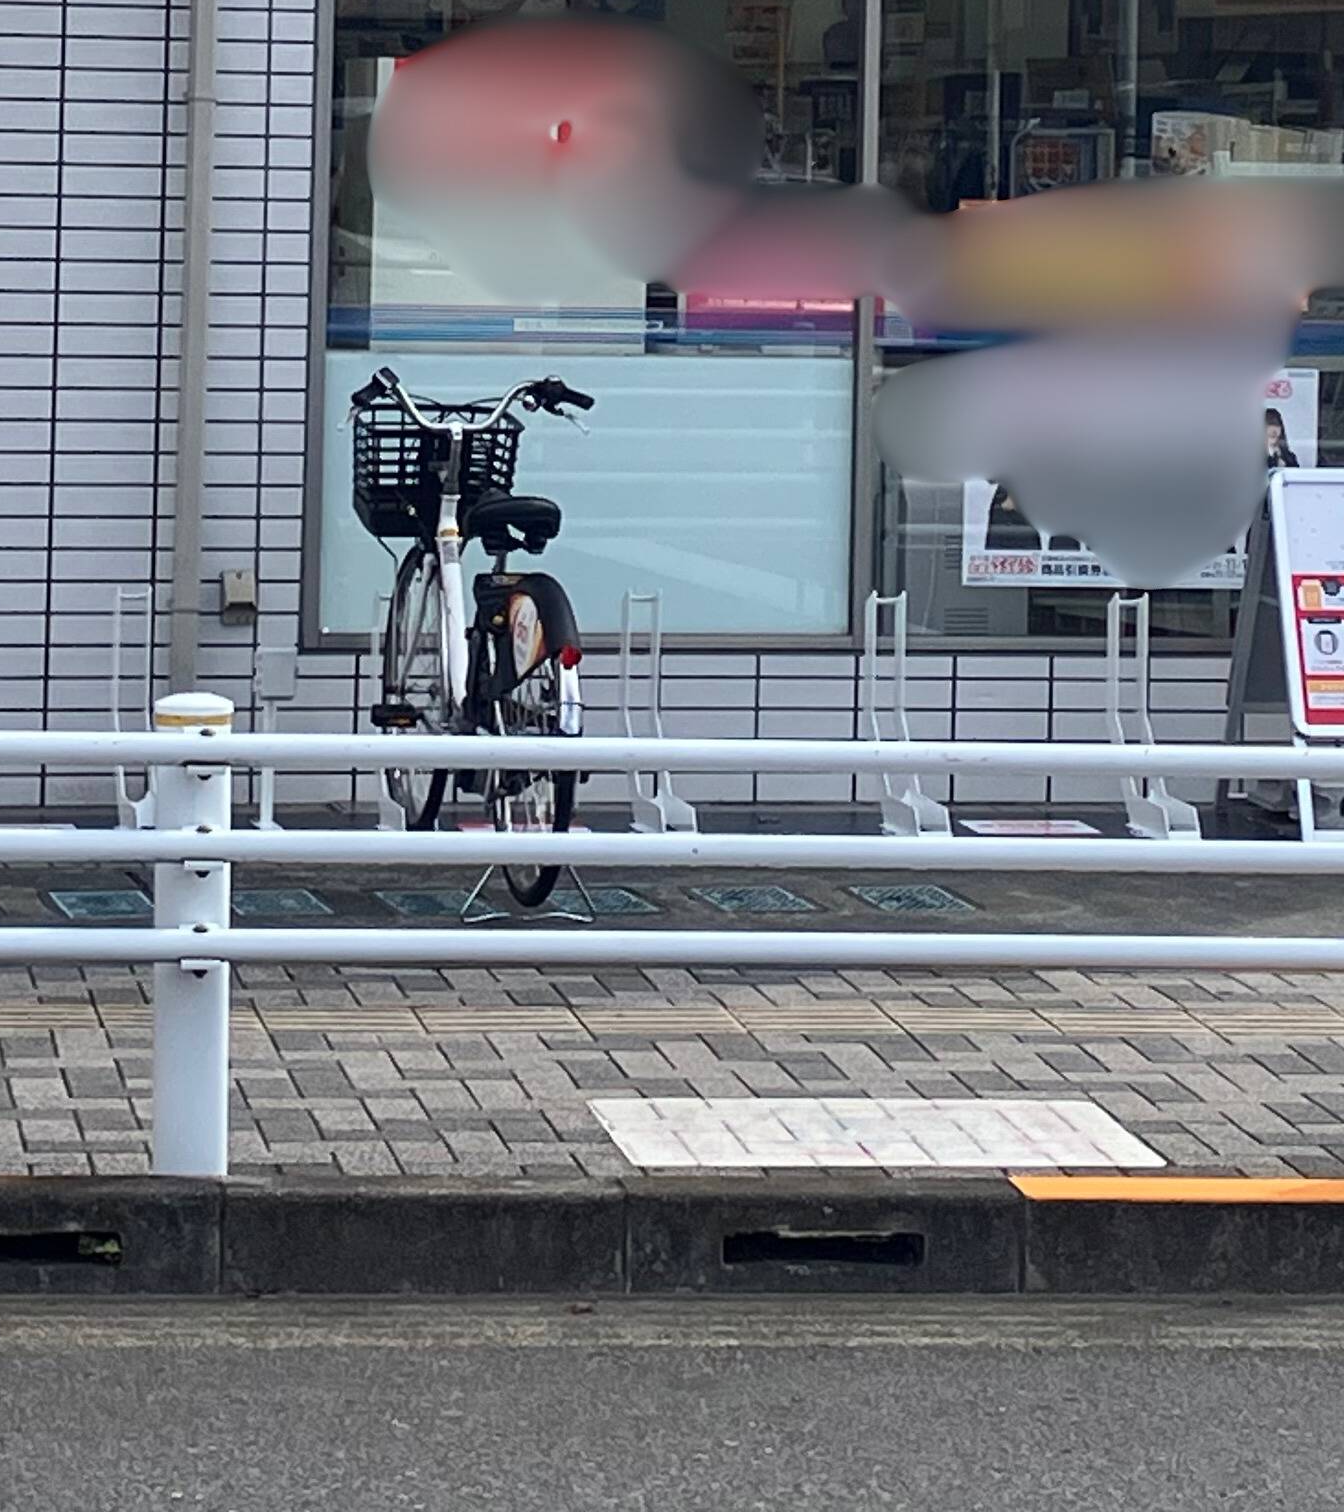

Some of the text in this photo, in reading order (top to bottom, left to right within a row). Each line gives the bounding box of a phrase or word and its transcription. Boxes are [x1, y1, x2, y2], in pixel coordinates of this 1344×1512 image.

[1041, 563, 1111, 577] 商品引換券
